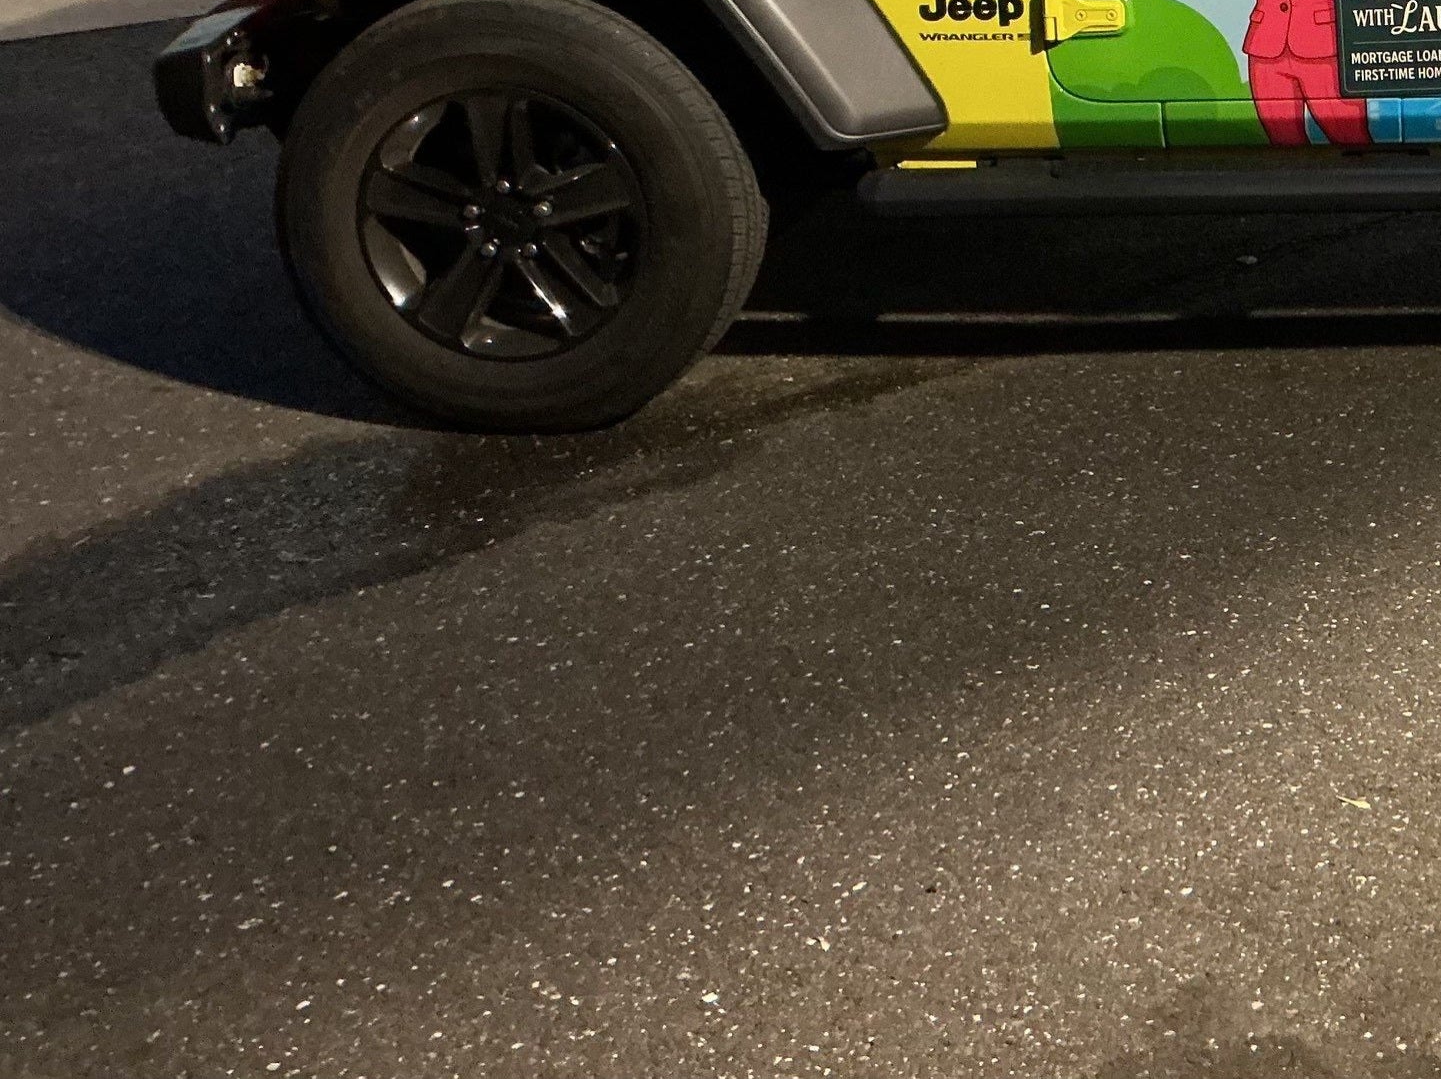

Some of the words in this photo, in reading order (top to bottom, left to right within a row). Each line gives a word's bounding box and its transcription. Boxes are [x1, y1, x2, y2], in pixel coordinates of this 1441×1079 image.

[1353, 8, 1395, 27] WITH
[918, 32, 1015, 41] WRANGLER
[1351, 50, 1414, 65] MORTGAGE
[1354, 68, 1416, 82] FIRST-TIME
